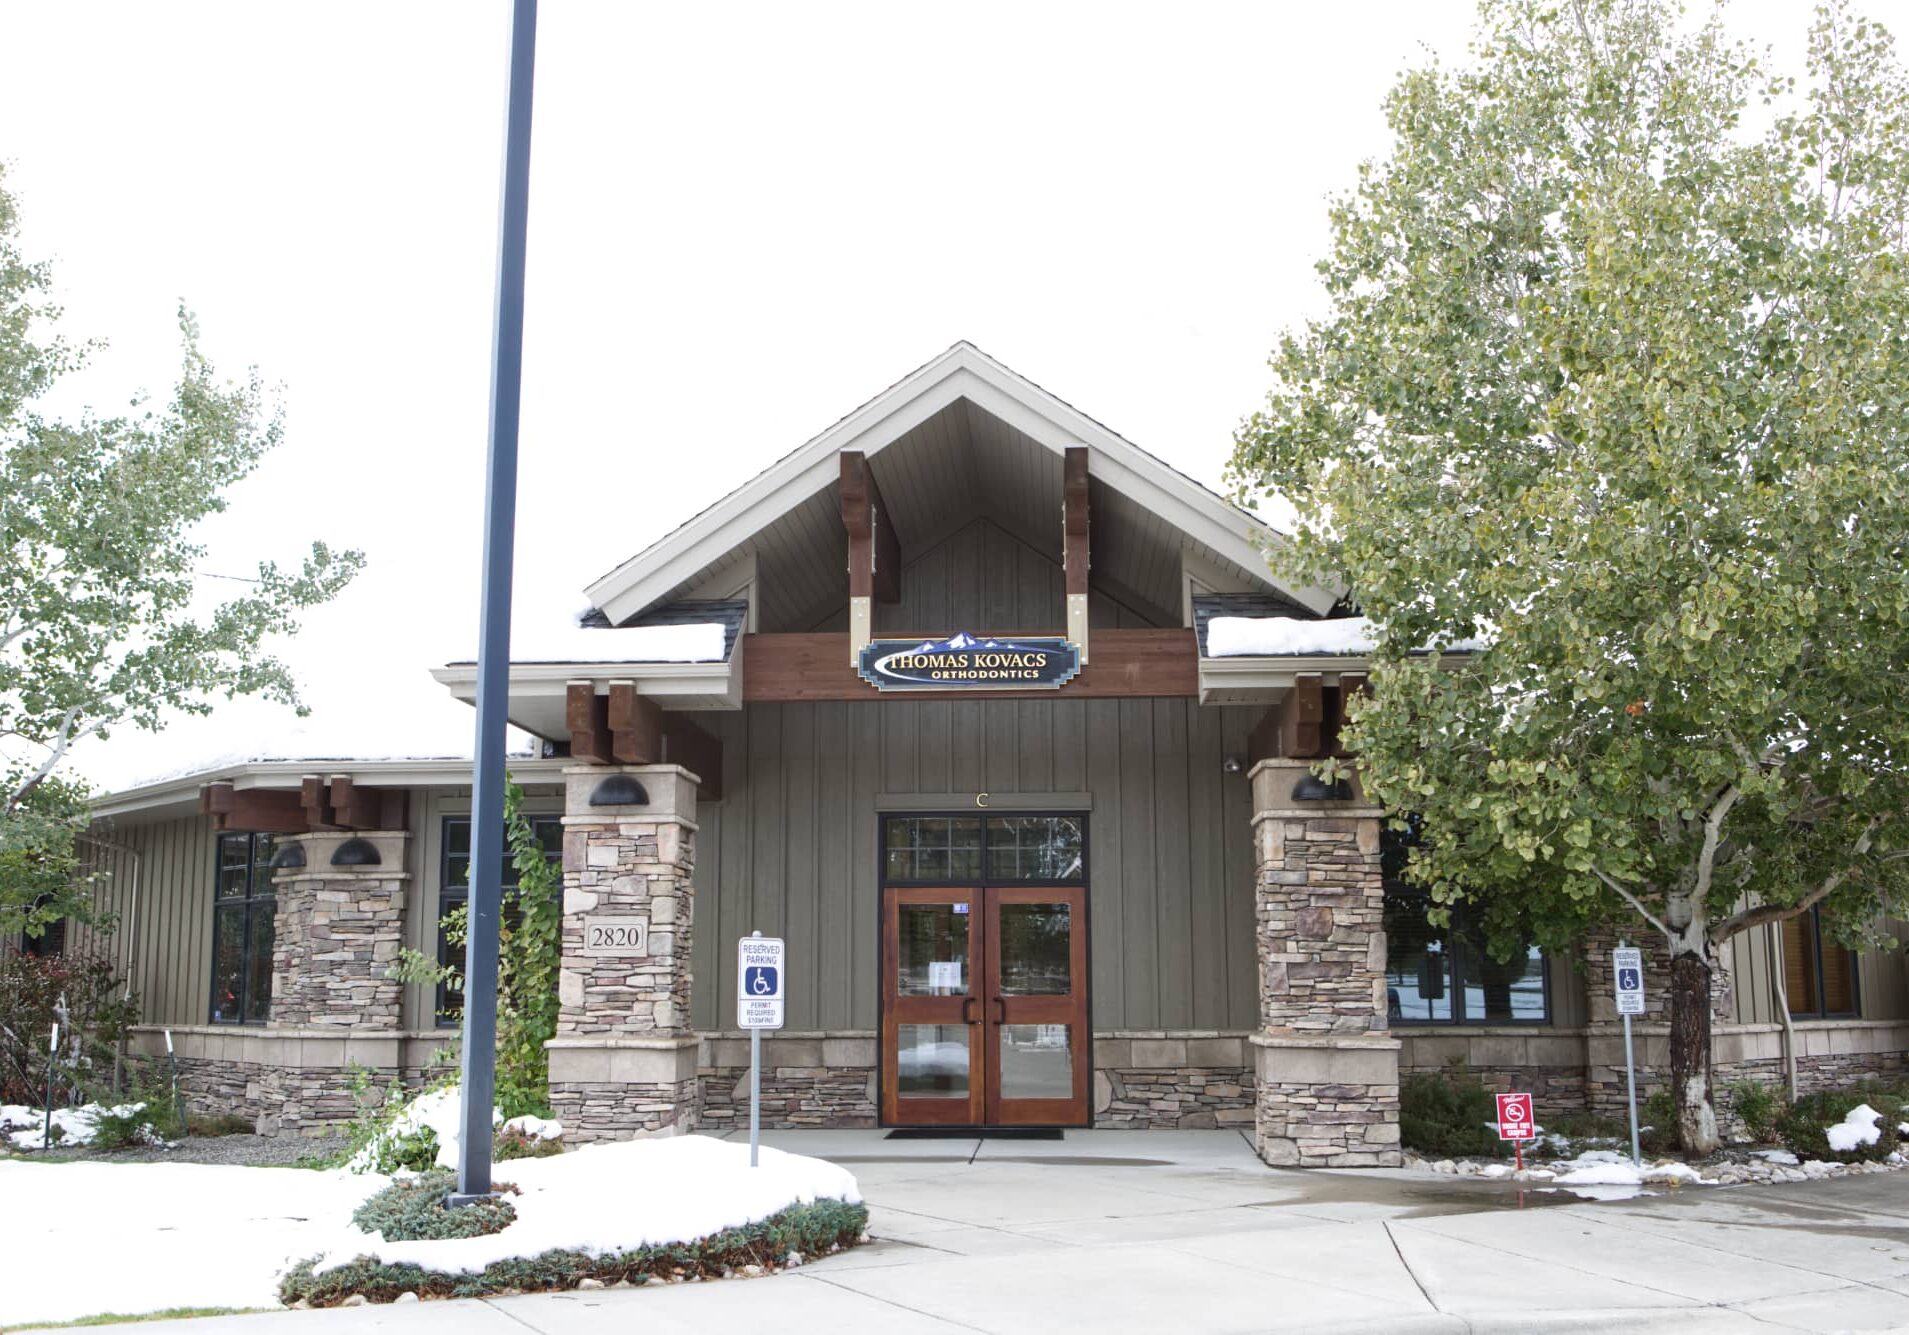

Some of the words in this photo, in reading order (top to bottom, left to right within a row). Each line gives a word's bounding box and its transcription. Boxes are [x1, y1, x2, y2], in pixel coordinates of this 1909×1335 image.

[889, 653, 968, 668] THOMAS
[974, 653, 1047, 668] KOVACS
[931, 669, 1040, 679] ORTHODONTICS
[976, 792, 988, 807] C
[592, 927, 639, 947] 2820
[743, 944, 781, 954] RESERVED
[746, 955, 777, 965] PARKING
